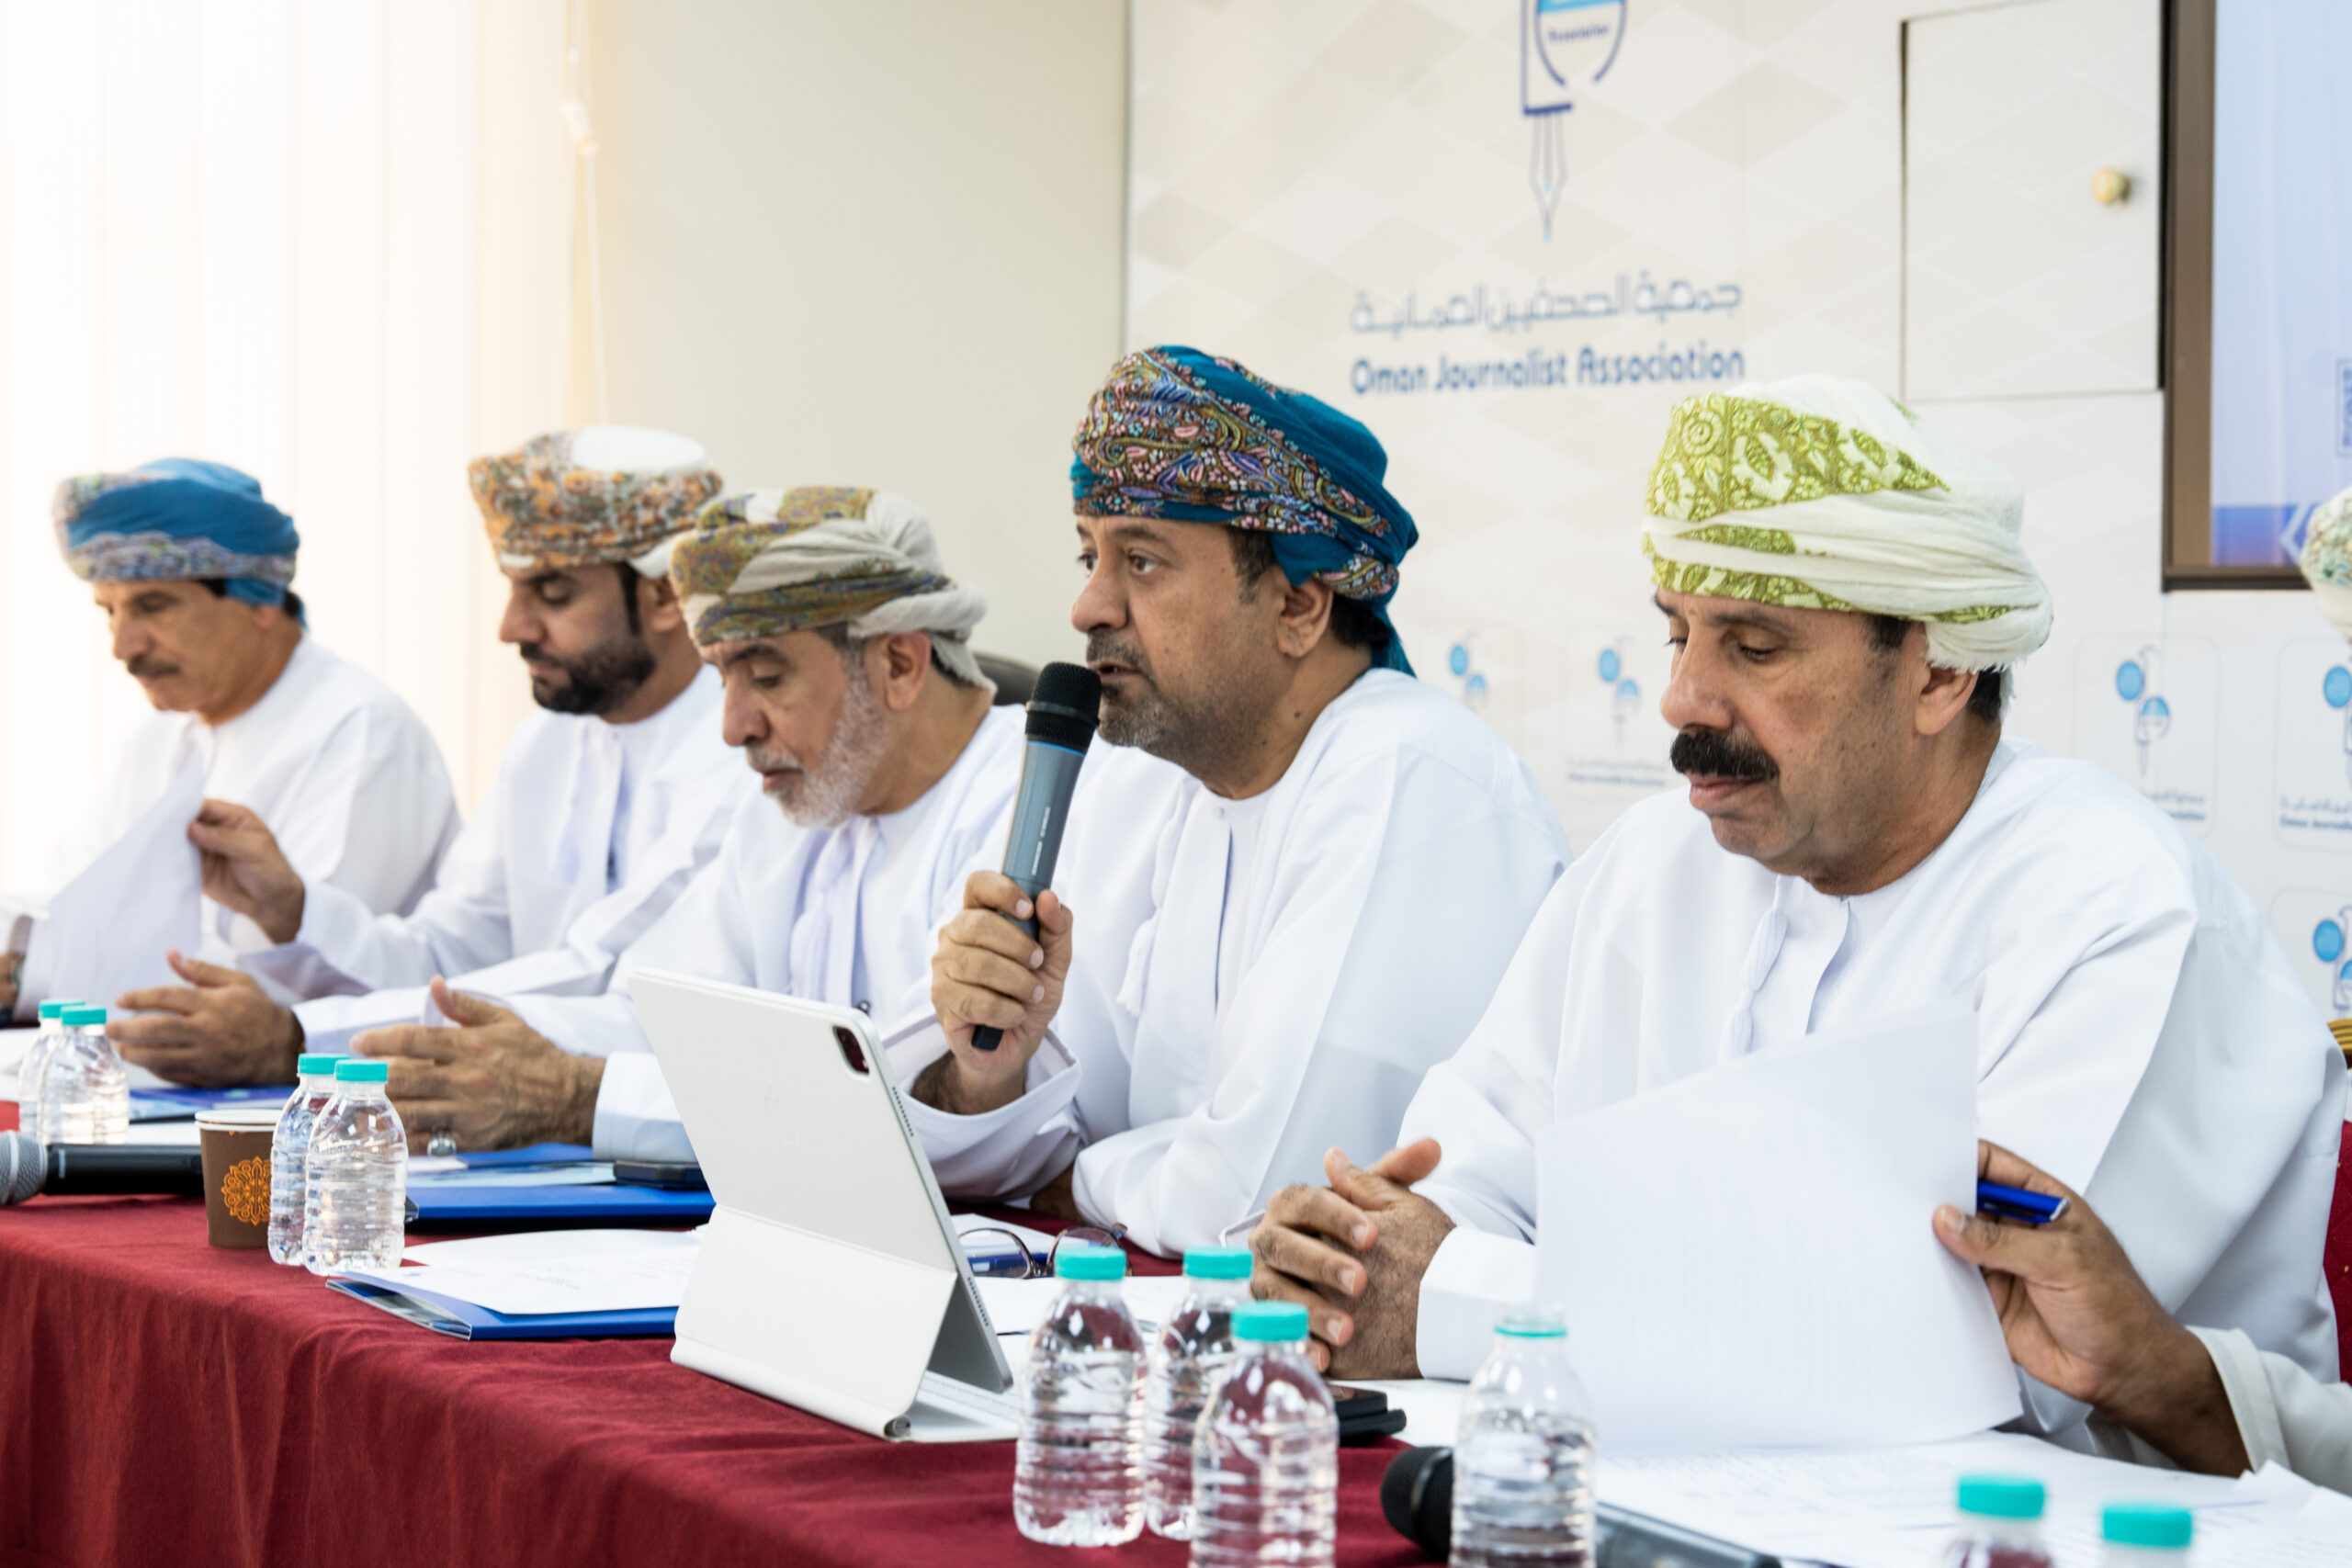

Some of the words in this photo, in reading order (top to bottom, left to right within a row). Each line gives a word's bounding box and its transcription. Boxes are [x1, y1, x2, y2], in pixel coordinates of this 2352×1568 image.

[1351, 283, 1486, 340] العمانية
[1485, 273, 1631, 333] الصحفيين
[1632, 270, 1742, 321] جمعية
[1351, 358, 1428, 395] Oman
[1434, 347, 1566, 392] Journalist
[1577, 340, 1744, 387] Association
